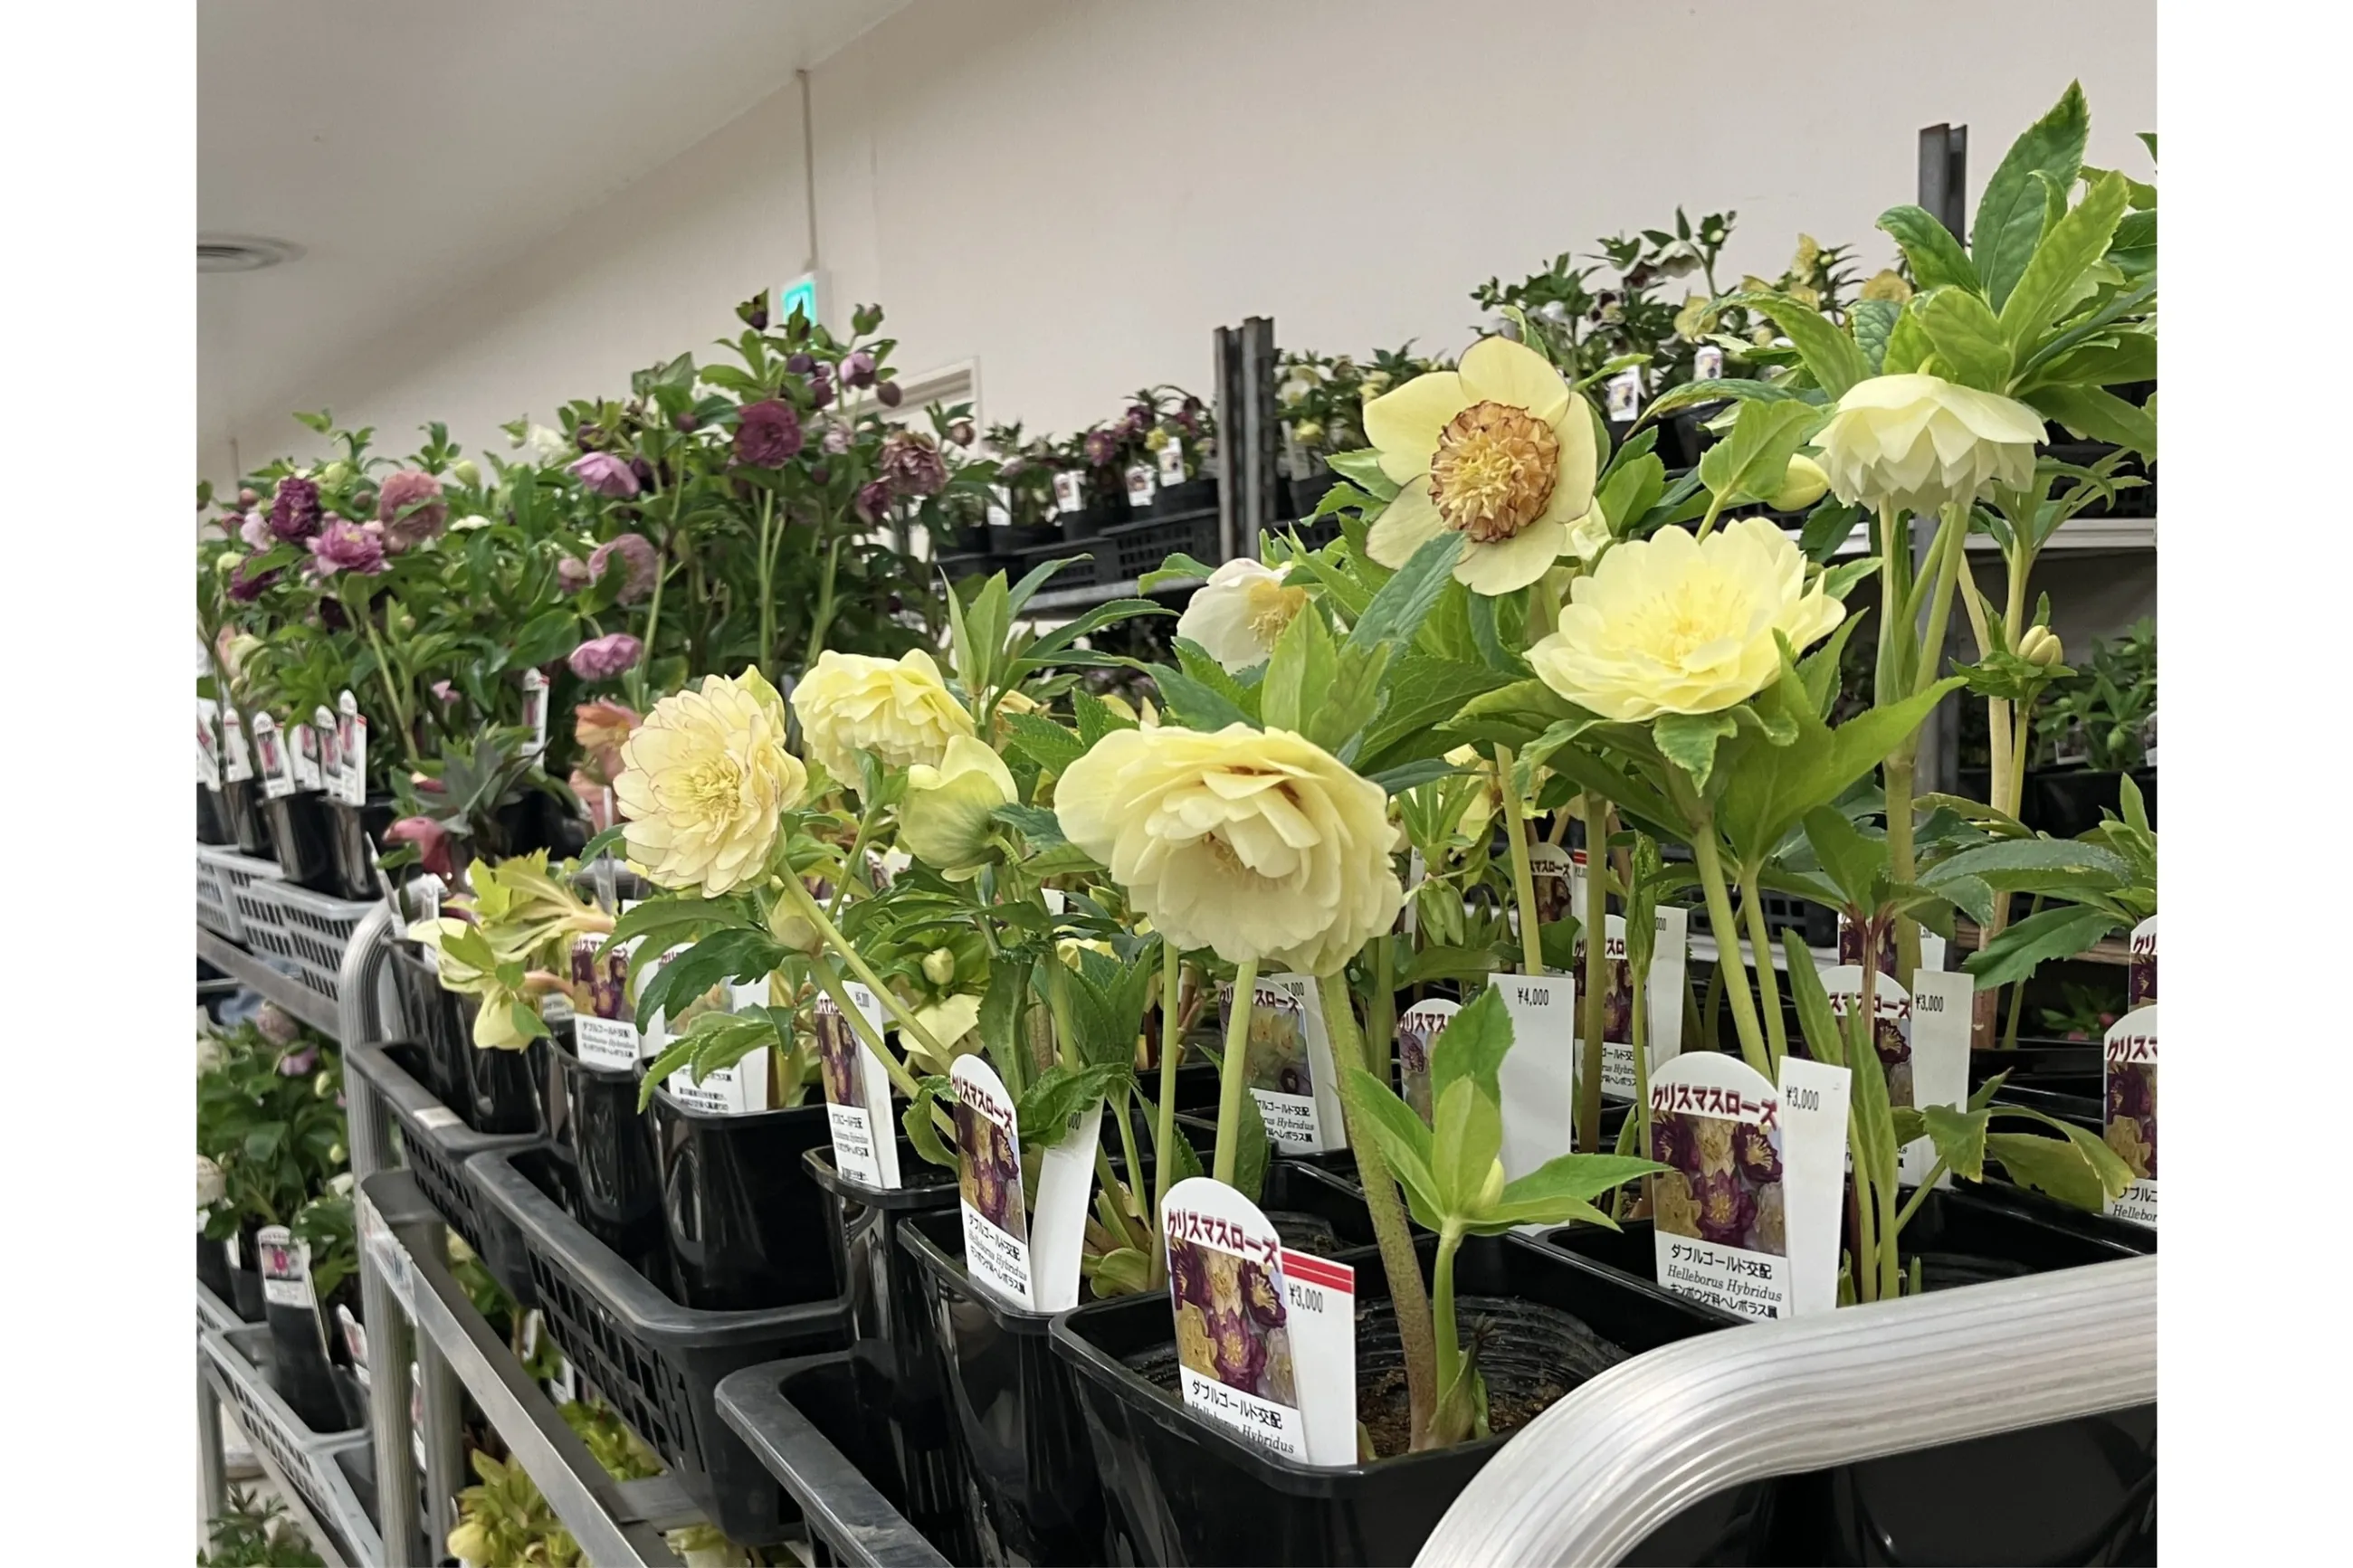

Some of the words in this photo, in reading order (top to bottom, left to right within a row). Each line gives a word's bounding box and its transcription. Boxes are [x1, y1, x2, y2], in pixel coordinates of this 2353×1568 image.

[1517, 987, 1549, 1006] ¥4,000
[1915, 994, 1945, 1012] ¥3,000
[951, 1074, 1014, 1137] クリスマスローズ
[1651, 1084, 1778, 1131] クリスマスローズ
[1786, 1085, 1819, 1111] ¥3,000
[1167, 1208, 1281, 1273] クリスマスローズ
[1671, 1243, 1772, 1280] ダブルゴールド交配
[1288, 1283, 1324, 1314] ¥3,000
[1667, 1264, 1724, 1289] Helleborus
[1727, 1278, 1783, 1303] Hybridus
[1192, 1379, 1283, 1430] ダブルゴールド交配
[1242, 1423, 1295, 1455] Hybridus
